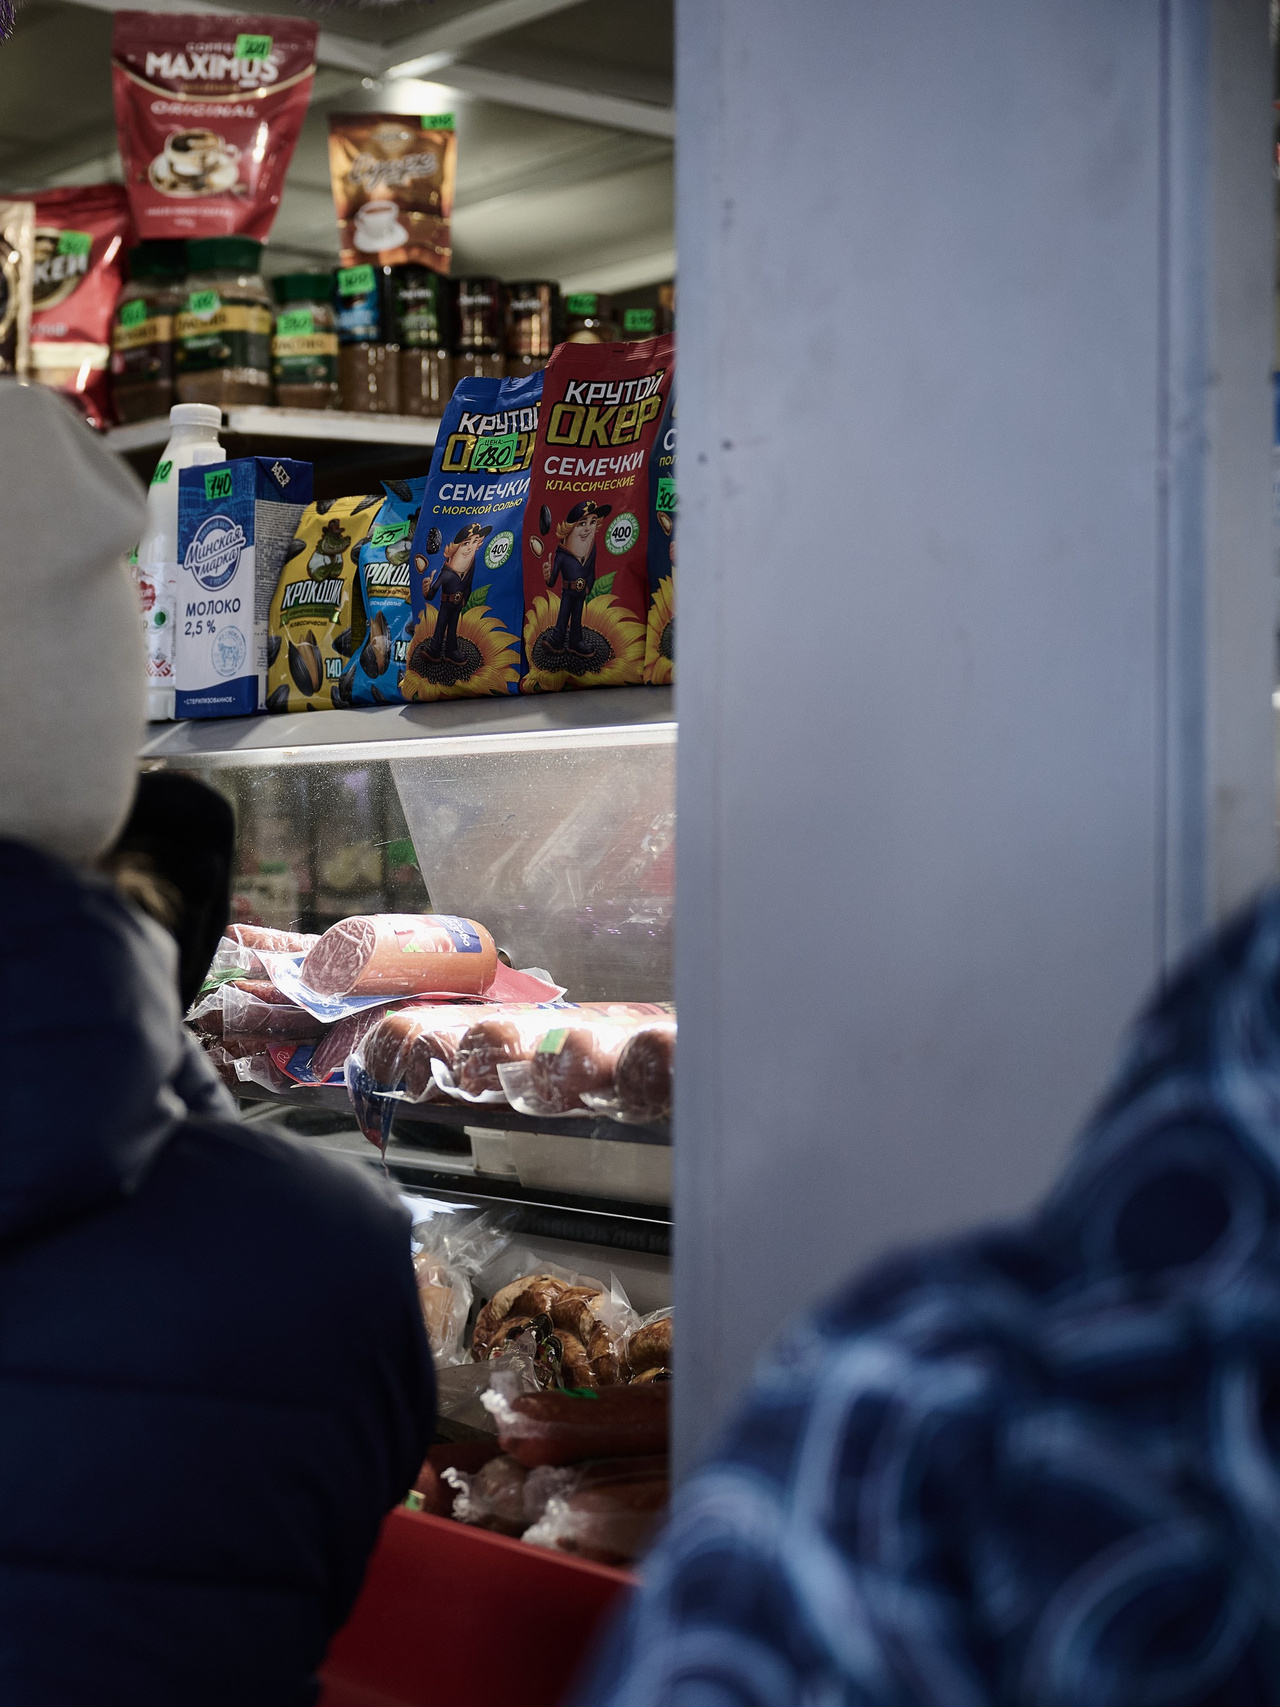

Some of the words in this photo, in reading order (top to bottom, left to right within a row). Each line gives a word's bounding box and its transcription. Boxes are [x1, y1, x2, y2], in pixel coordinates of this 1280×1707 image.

[146, 51, 279, 83] MAXIMUS
[565, 369, 665, 404] КРУТОЙ
[546, 394, 663, 447] ОКЕР
[476, 446, 511, 466] 180
[544, 450, 645, 477] СЕМЕЧКИ
[210, 473, 232, 498] 140
[438, 477, 531, 501] СЕМЕЧКИ
[545, 475, 636, 492] КЛАССИЧЕСКИЕ
[432, 505, 440, 515] С
[442, 502, 492, 515] МОРСКОЙ
[493, 498, 523, 512] СОЛЬЮ
[612, 526, 631, 538] 400
[186, 527, 241, 566] Минская
[491, 543, 508, 554] 400
[200, 549, 236, 576] марка
[186, 598, 241, 617] МОЛОКО
[185, 621, 202, 637] 2,5
[207, 620, 216, 635] %
[325, 659, 341, 678] 140
[186, 695, 234, 706] СТЕРИЛИЗОВАННОЕ
